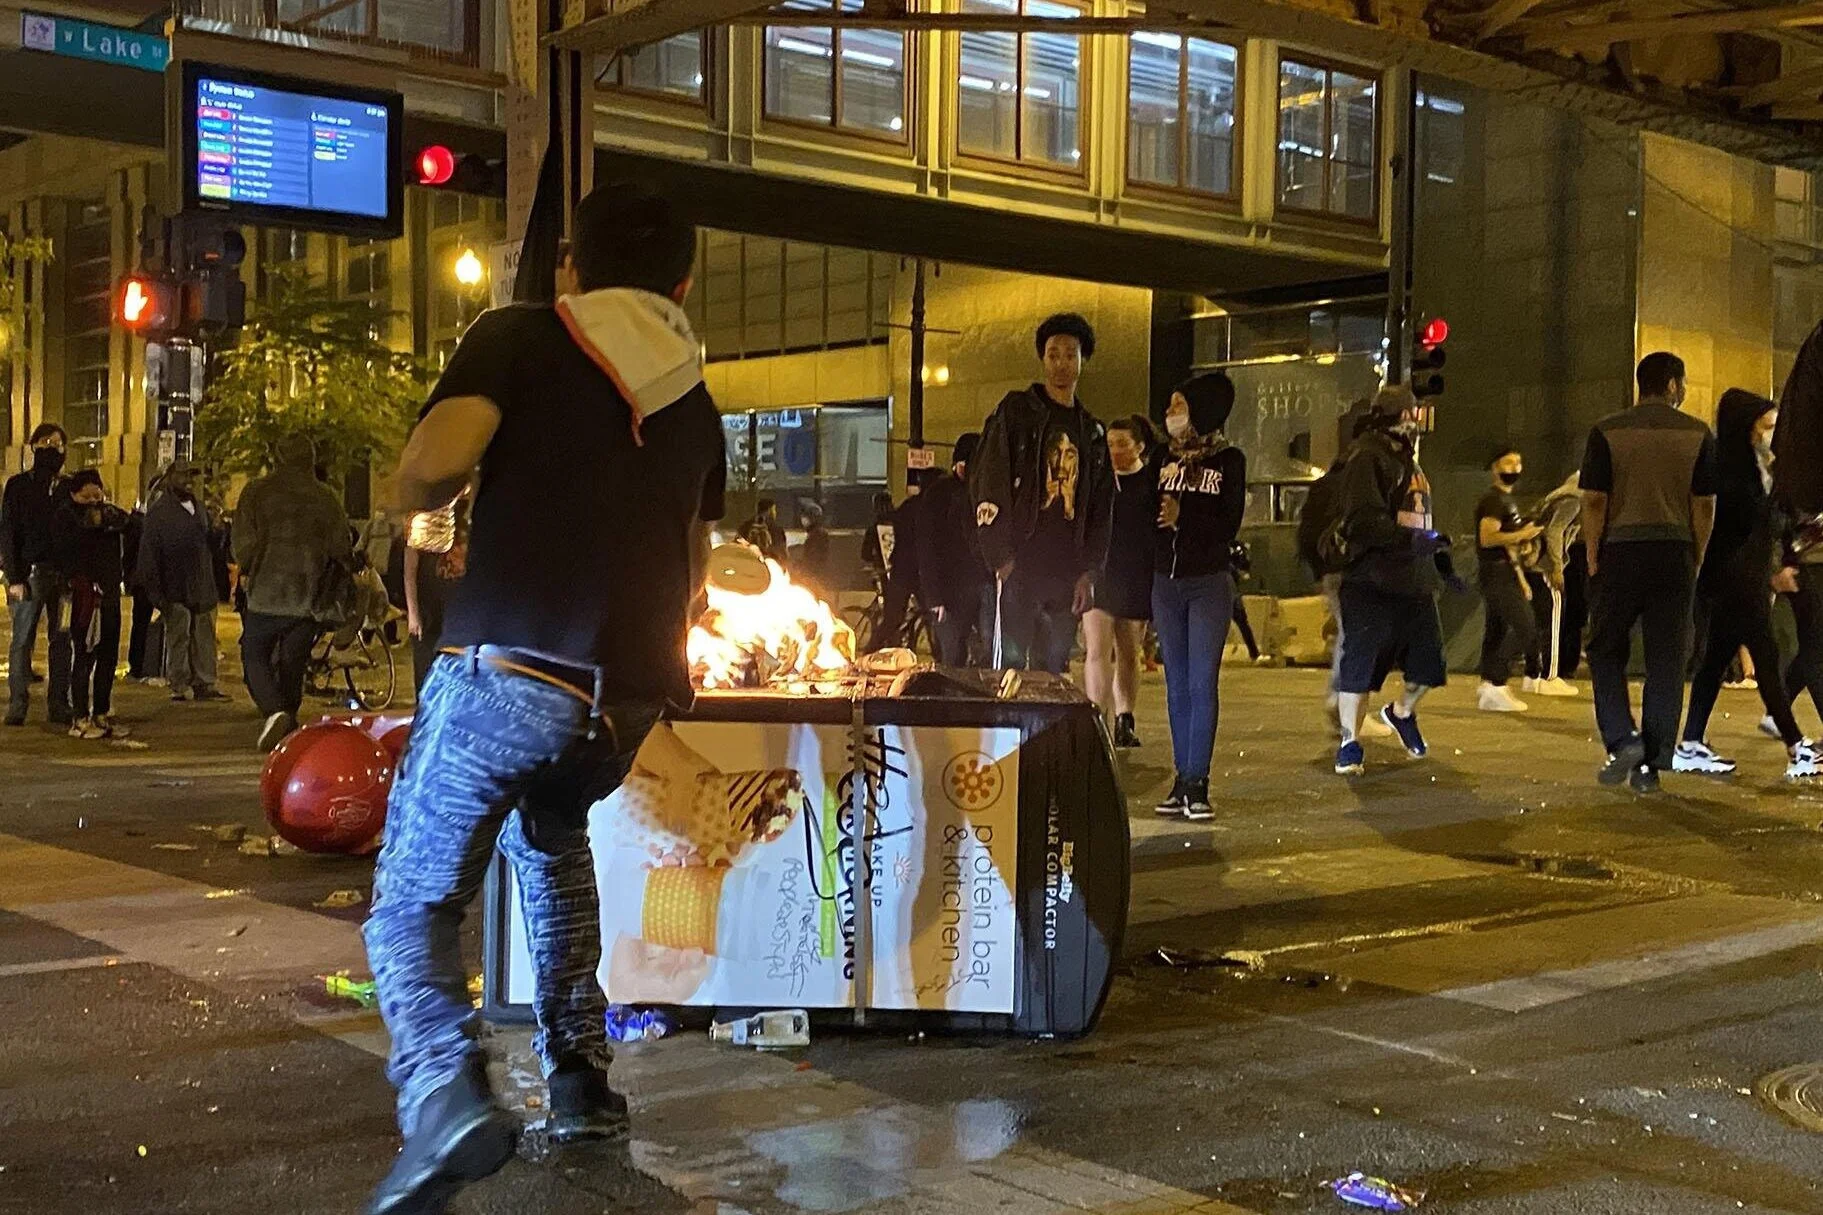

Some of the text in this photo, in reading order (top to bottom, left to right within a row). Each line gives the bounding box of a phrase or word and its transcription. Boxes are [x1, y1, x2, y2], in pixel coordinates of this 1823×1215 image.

[82, 27, 142, 59] Lake
[1158, 466, 1223, 495] INK
[943, 824, 968, 844] &
[1045, 797, 1060, 950] OLAR COMPACTOR
[871, 884, 883, 907] UP
[942, 855, 968, 962] kitchen
[972, 824, 997, 989] protein bar
